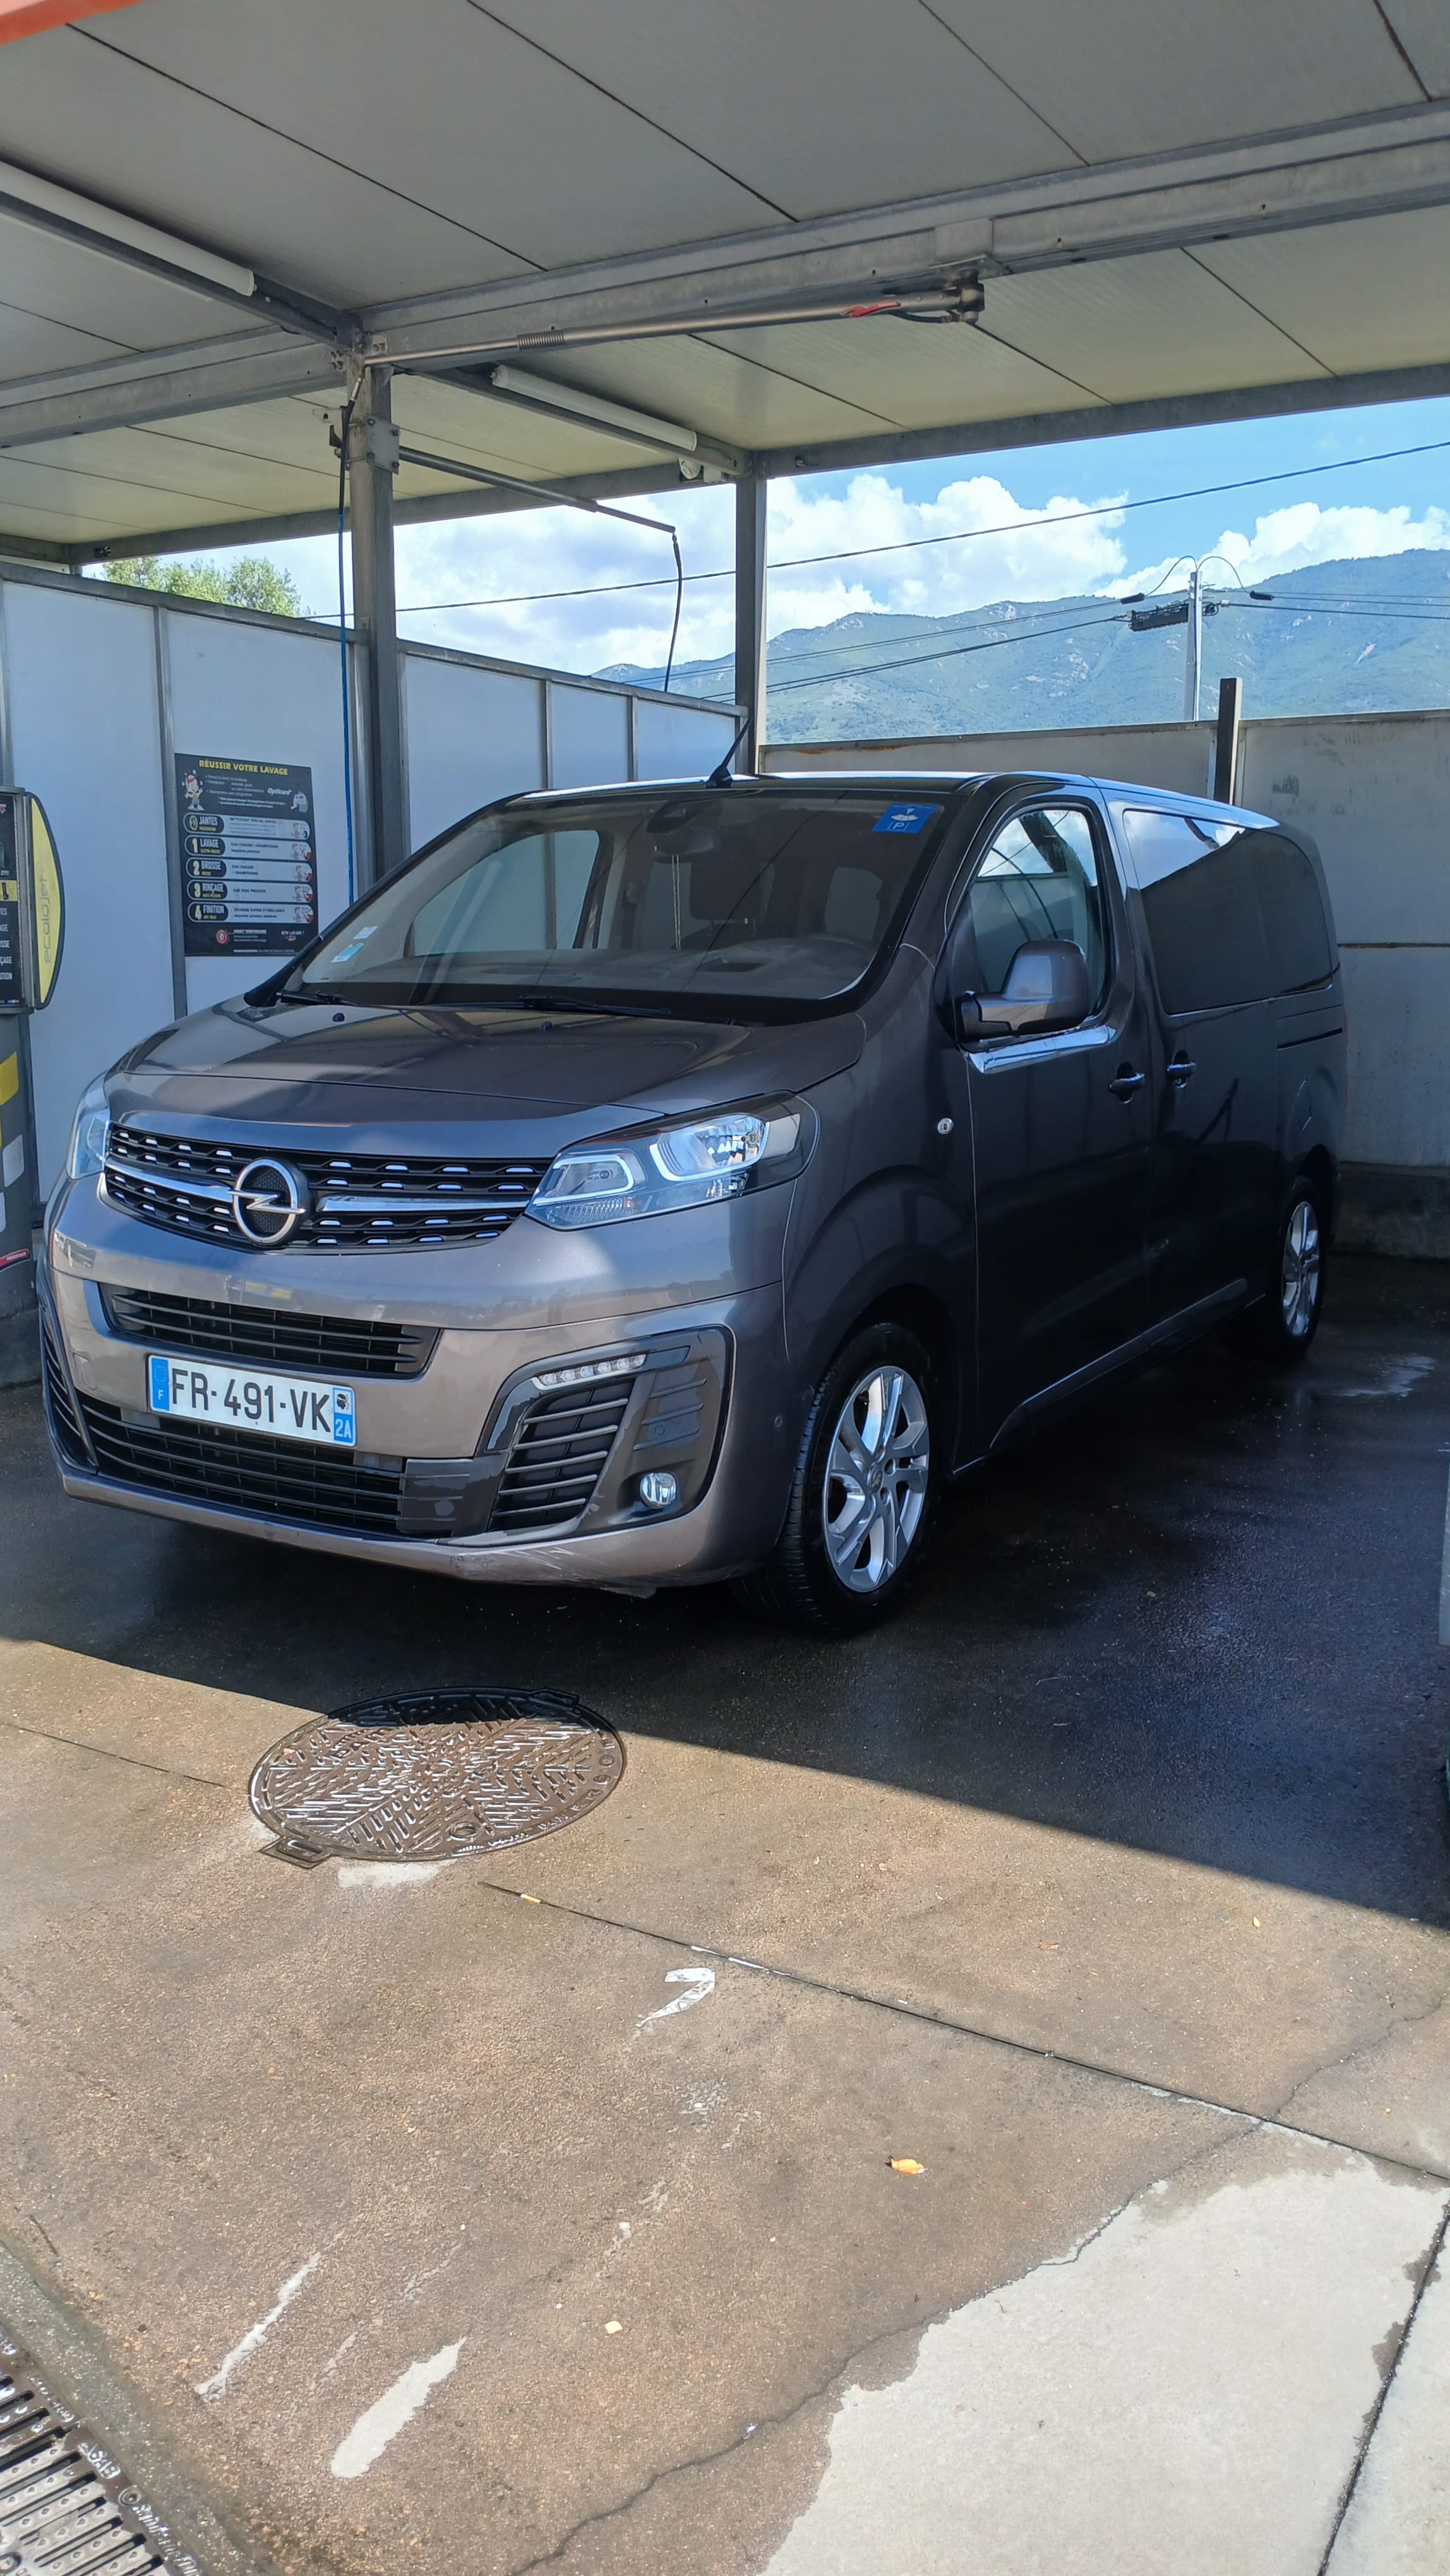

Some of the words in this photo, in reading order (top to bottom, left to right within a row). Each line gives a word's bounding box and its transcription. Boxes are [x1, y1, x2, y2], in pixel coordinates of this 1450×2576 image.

[199, 759, 231, 770] RÉUSSIR
[233, 763, 258, 773] VOTRE
[260, 766, 288, 775] LAVAGE
[199, 816, 218, 826] JANTES
[192, 838, 198, 853] 1
[200, 838, 220, 848] LAVAGE
[193, 860, 200, 875] 2
[201, 861, 222, 870] BROSSE
[194, 883, 201, 898] 3
[202, 883, 224, 894] RINÇAGE
[195, 905, 202, 920] 4
[203, 905, 224, 914] FINITION
[158, 1390, 164, 1400] F
[172, 1368, 331, 1433] FR-491-VK
[335, 1418, 352, 1439] 2A
